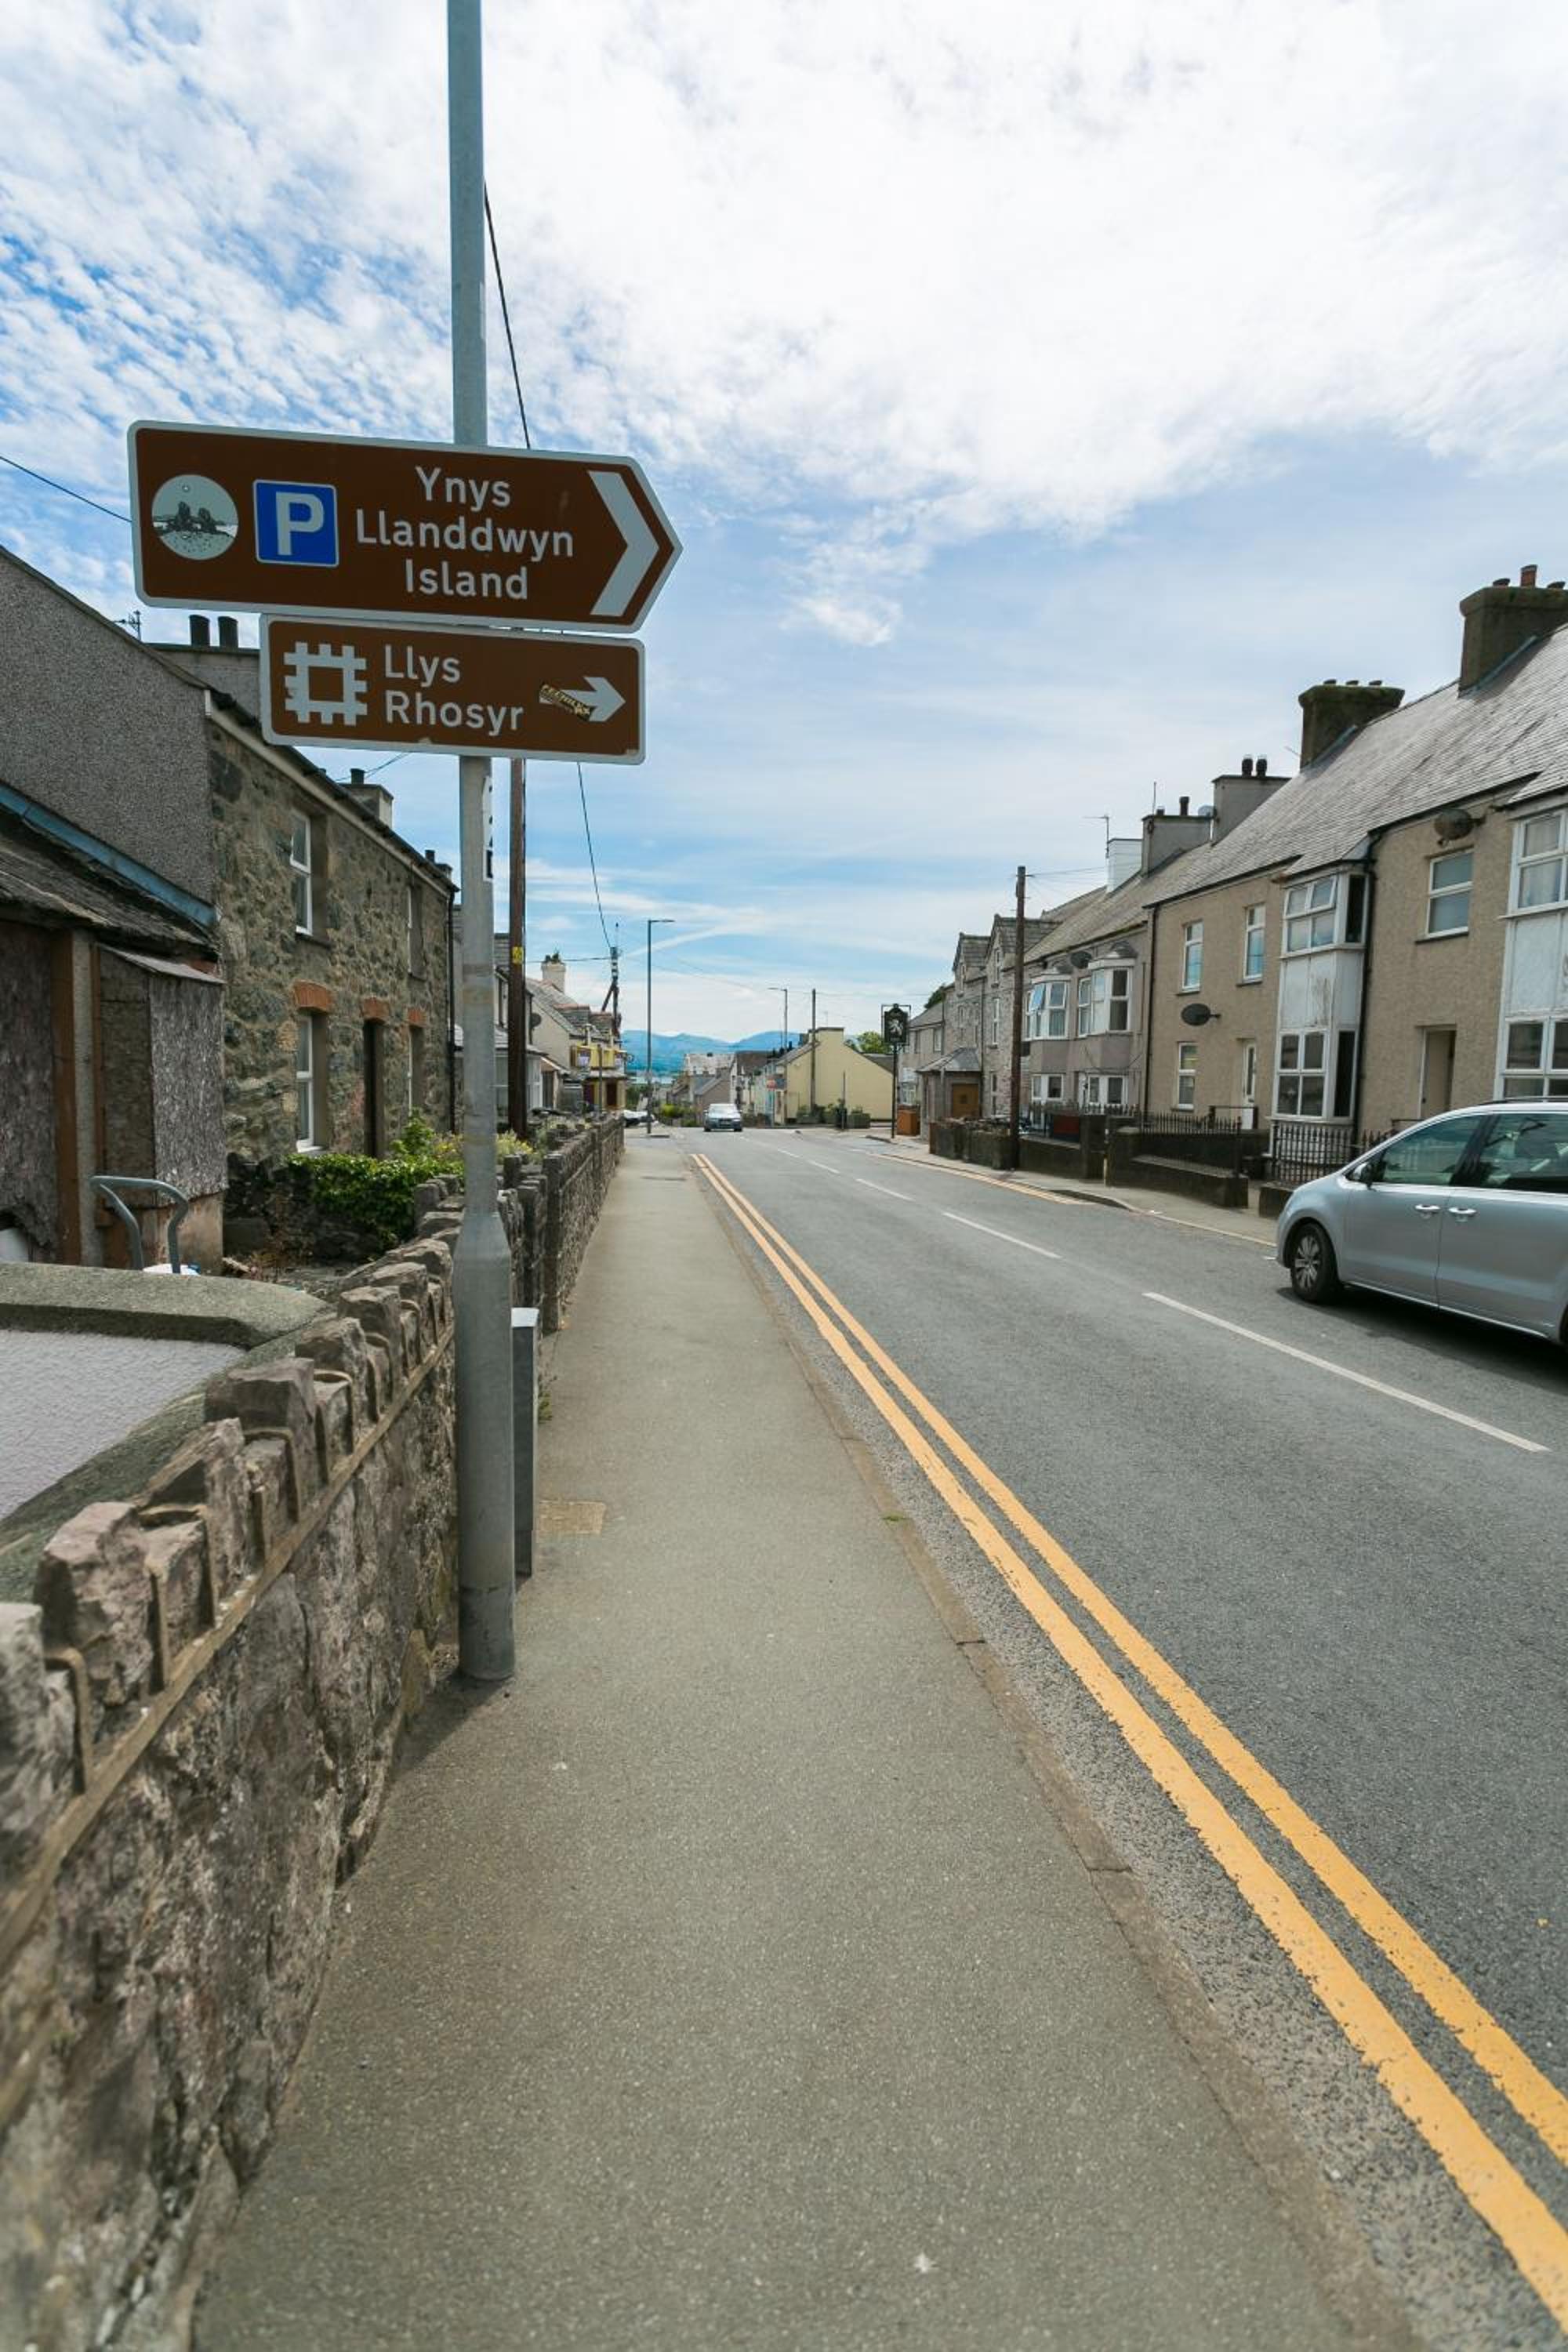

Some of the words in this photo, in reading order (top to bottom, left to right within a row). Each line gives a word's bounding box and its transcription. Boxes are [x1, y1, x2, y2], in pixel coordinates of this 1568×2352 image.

[416, 466, 510, 512] Ynys
[276, 492, 325, 555] P
[356, 508, 573, 562] Llanddwyn
[405, 559, 528, 600] Island
[385, 644, 461, 688] Llys
[385, 689, 524, 737] Rhosyr
